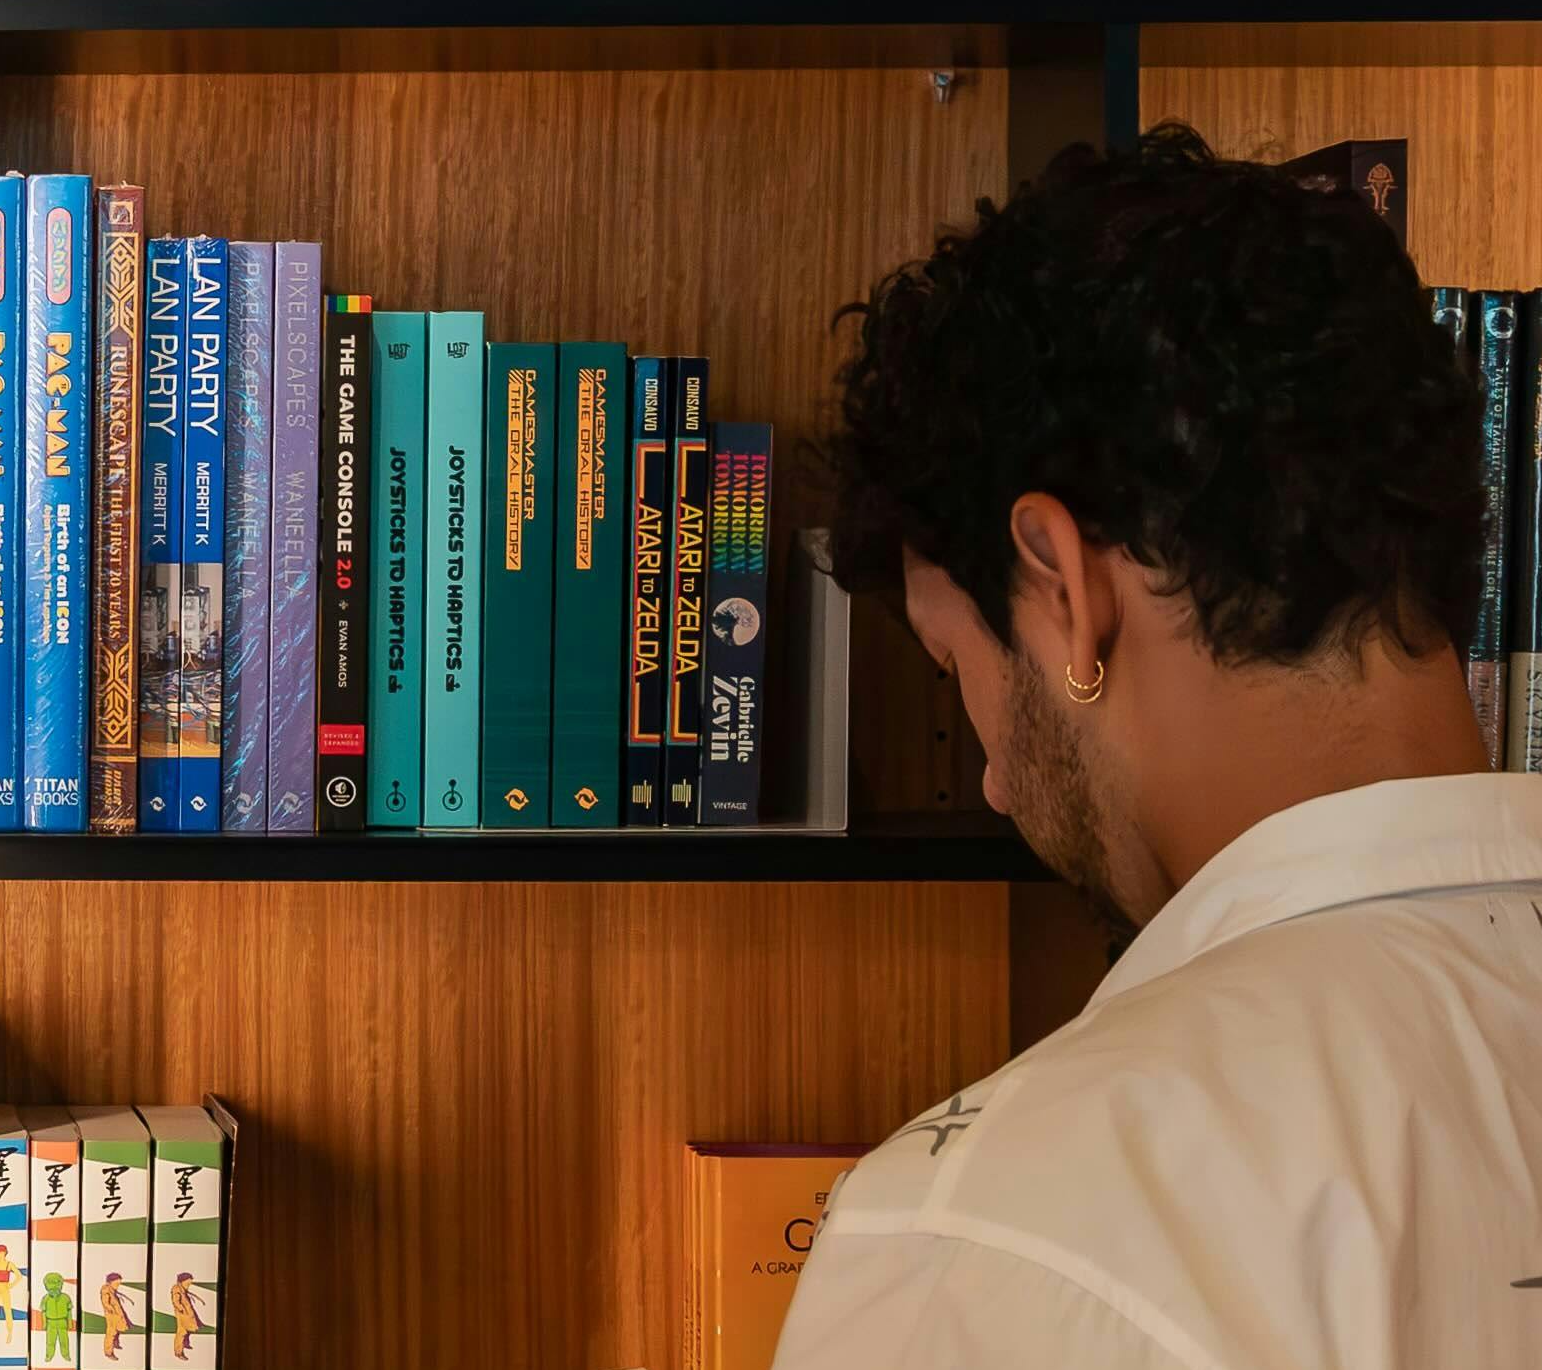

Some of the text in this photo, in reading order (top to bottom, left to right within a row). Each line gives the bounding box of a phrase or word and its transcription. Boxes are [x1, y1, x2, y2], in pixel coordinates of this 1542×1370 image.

[191, 257, 221, 436] LAN PARTY
[685, 377, 700, 430] CONSALVO
[336, 334, 356, 589] THE GAME CONSOLE 2.0
[446, 445, 465, 671] JOYSTICKS TO HAPTICS
[676, 503, 703, 675] ATARI TO ZELDA
[337, 620, 349, 688] EVAN AMOS
